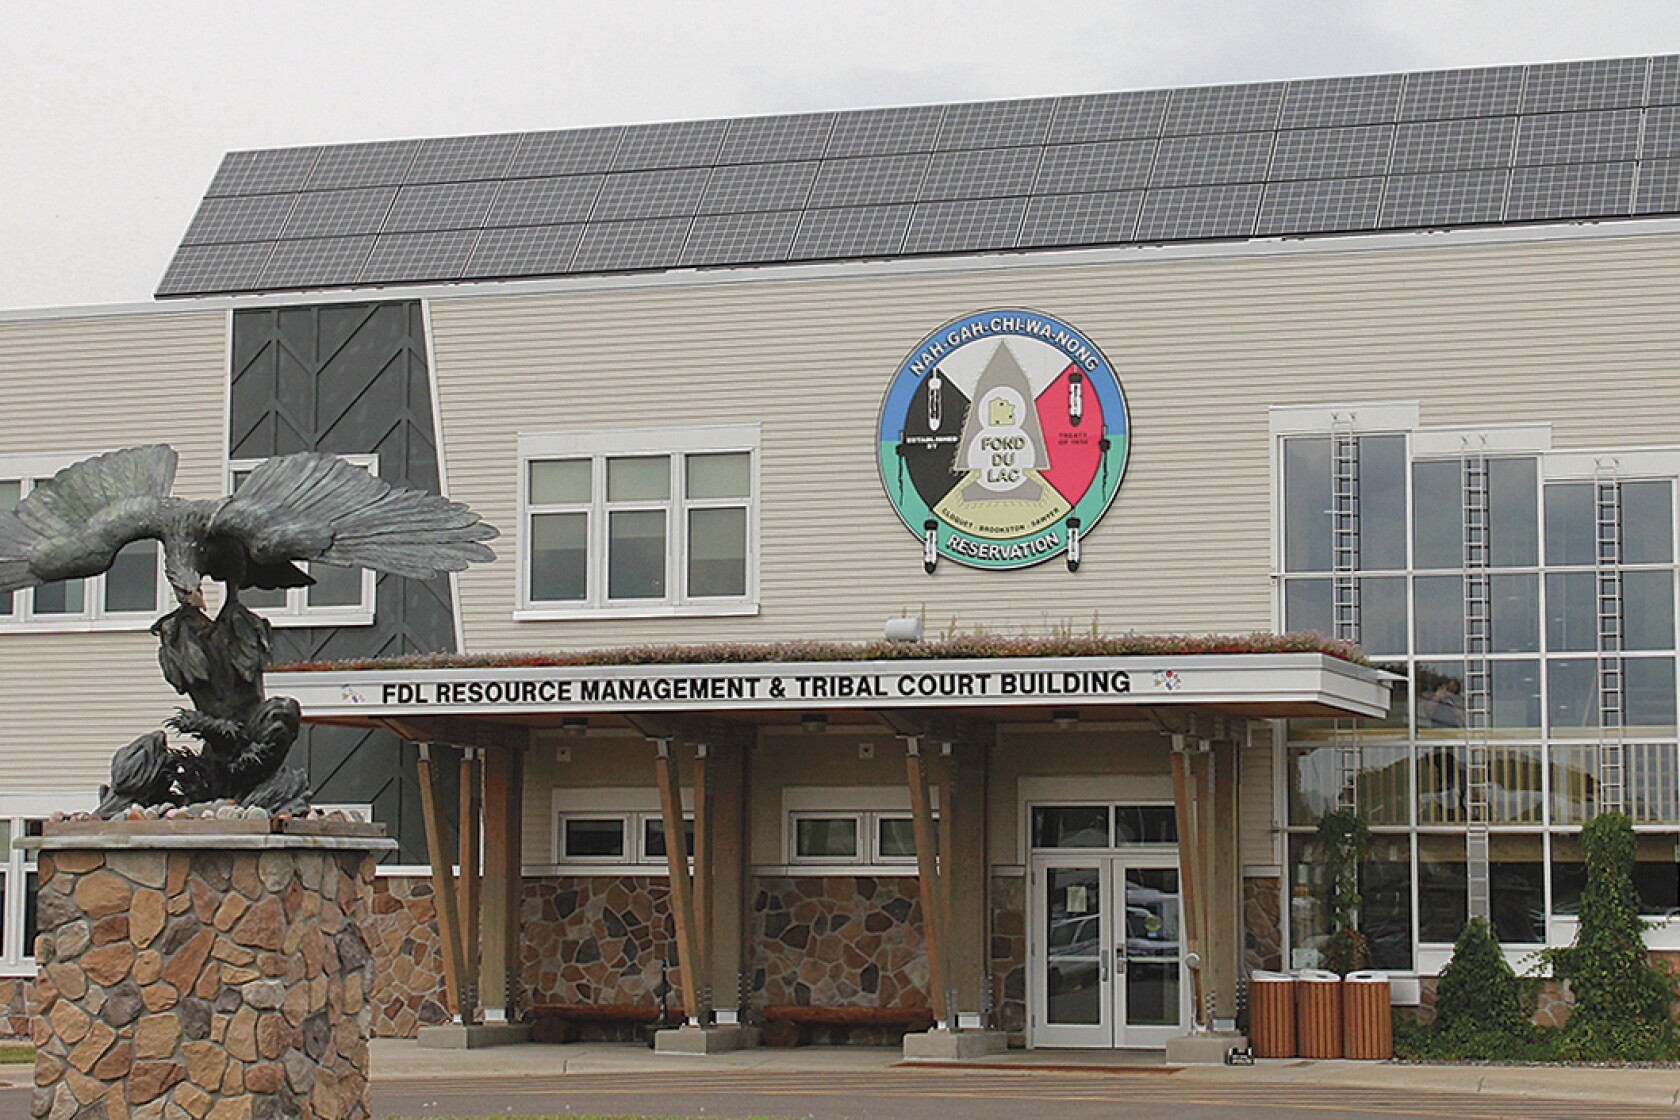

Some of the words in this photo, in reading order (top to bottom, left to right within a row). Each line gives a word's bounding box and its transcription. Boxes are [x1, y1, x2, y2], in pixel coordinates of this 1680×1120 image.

[909, 317, 1100, 377] NAH-GAH-CHI-WA-NONG
[981, 436, 1026, 451] FOND
[992, 452, 1015, 467] DU
[987, 469, 1020, 483] LAC
[946, 532, 1060, 560] RESERVATION
[383, 683, 428, 704] FDL
[436, 681, 572, 703] RESOURCE
[580, 677, 761, 700] MANAGEMENT
[769, 676, 786, 698] &
[795, 675, 888, 697] TRIBAL
[897, 673, 991, 695] COURT
[1001, 671, 1131, 694] BUILDING
